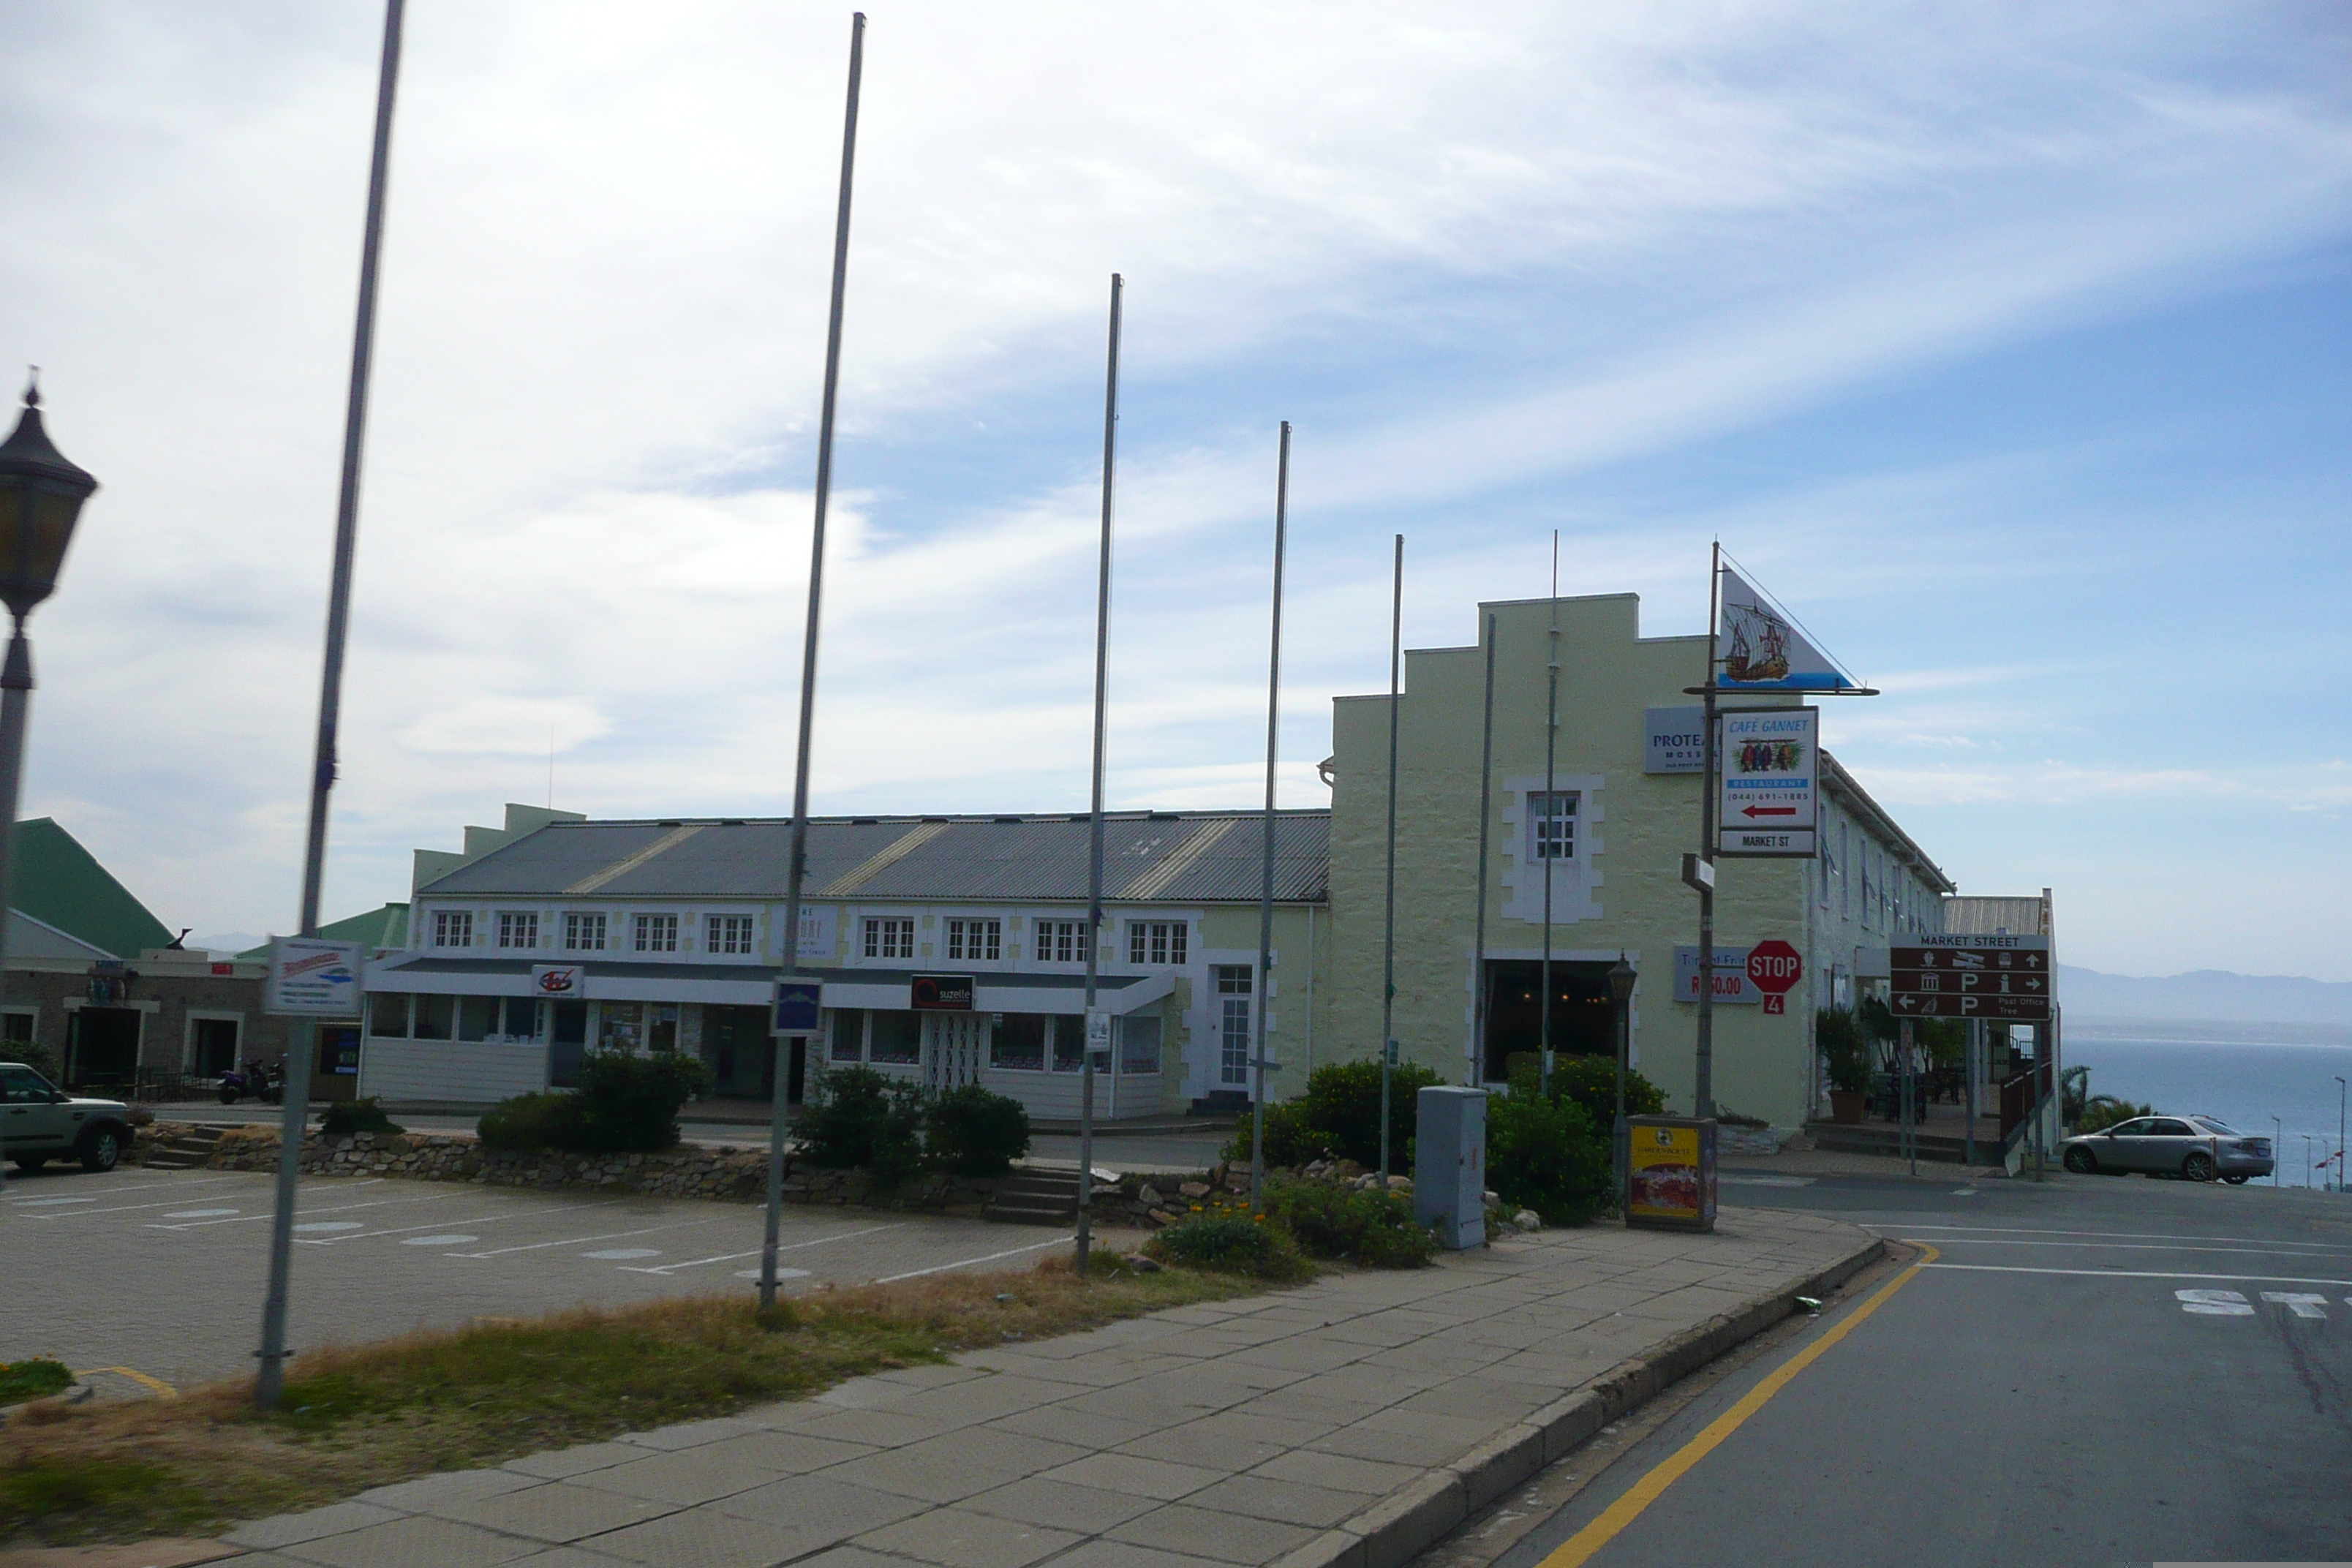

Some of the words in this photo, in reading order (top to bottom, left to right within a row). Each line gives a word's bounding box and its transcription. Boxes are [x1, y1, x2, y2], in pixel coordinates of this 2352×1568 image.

[1730, 718, 1759, 733] CAFÉ
[1762, 720, 1809, 732] GANNET
[1654, 734, 1705, 747] PROTE
[1733, 780, 1802, 788] RESTAURANT
[1742, 836, 1776, 847] MARKET
[1779, 836, 1790, 847] ST
[1921, 936, 1969, 946] MARKET
[1975, 937, 2019, 947] STREET
[1752, 956, 1798, 978] STOP
[1961, 973, 1978, 992] P
[939, 989, 970, 999] suzelle
[1768, 995, 1780, 1014] 4
[1961, 996, 1978, 1015] P
[1999, 998, 2017, 1006] Post
[2020, 998, 2045, 1006] Office
[2174, 1289, 2352, 1319] ST
